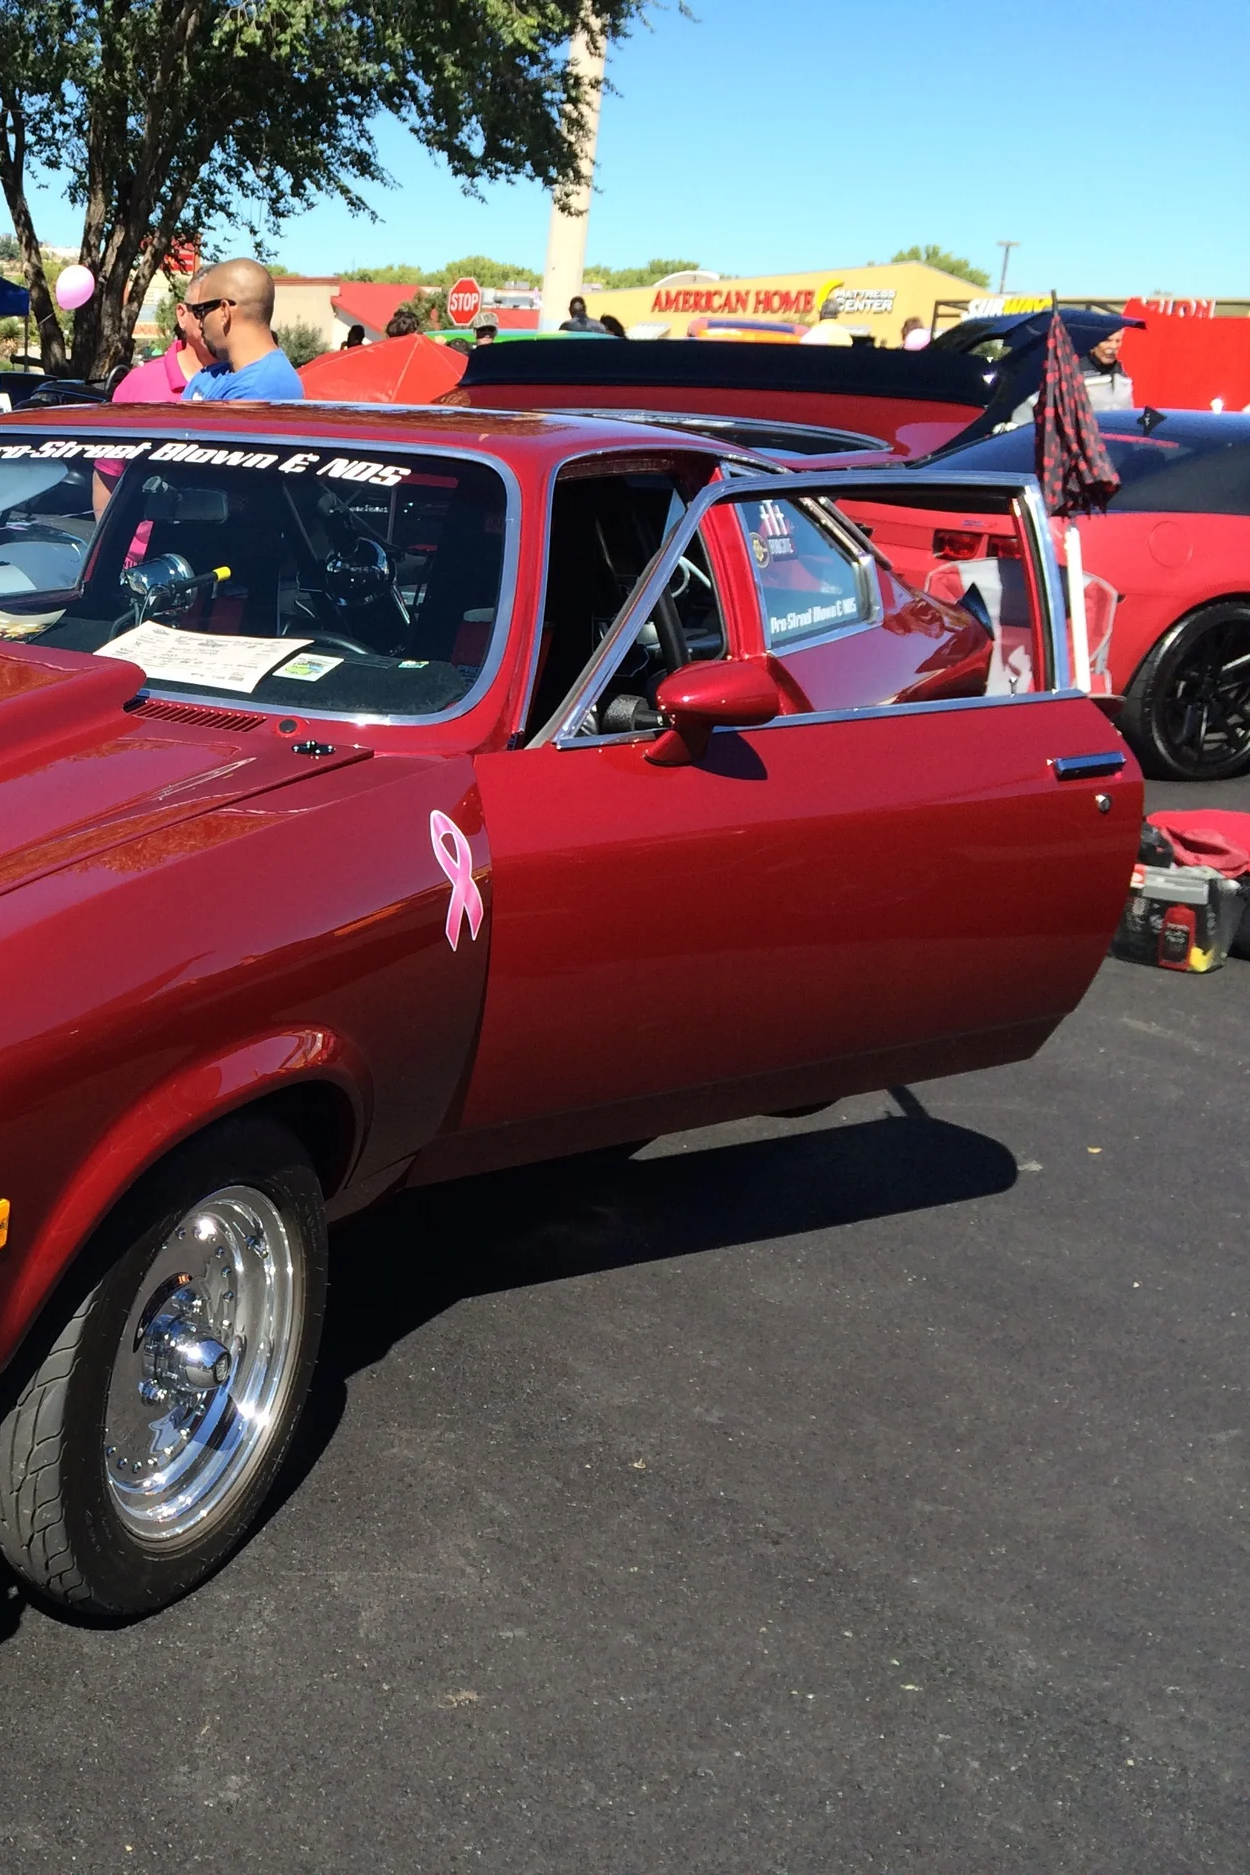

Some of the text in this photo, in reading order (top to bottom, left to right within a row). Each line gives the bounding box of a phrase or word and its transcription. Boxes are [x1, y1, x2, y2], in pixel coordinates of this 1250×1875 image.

[450, 292, 479, 311] STOP
[651, 290, 815, 313] AMERICAN HOME
[836, 288, 897, 300] MATTRESS
[837, 299, 894, 314] CENTER
[961, 297, 1053, 321] SUBWAY
[148, 442, 279, 469] Blown
[316, 458, 412, 487] NOS
[771, 608, 812, 634] Pro-Street
